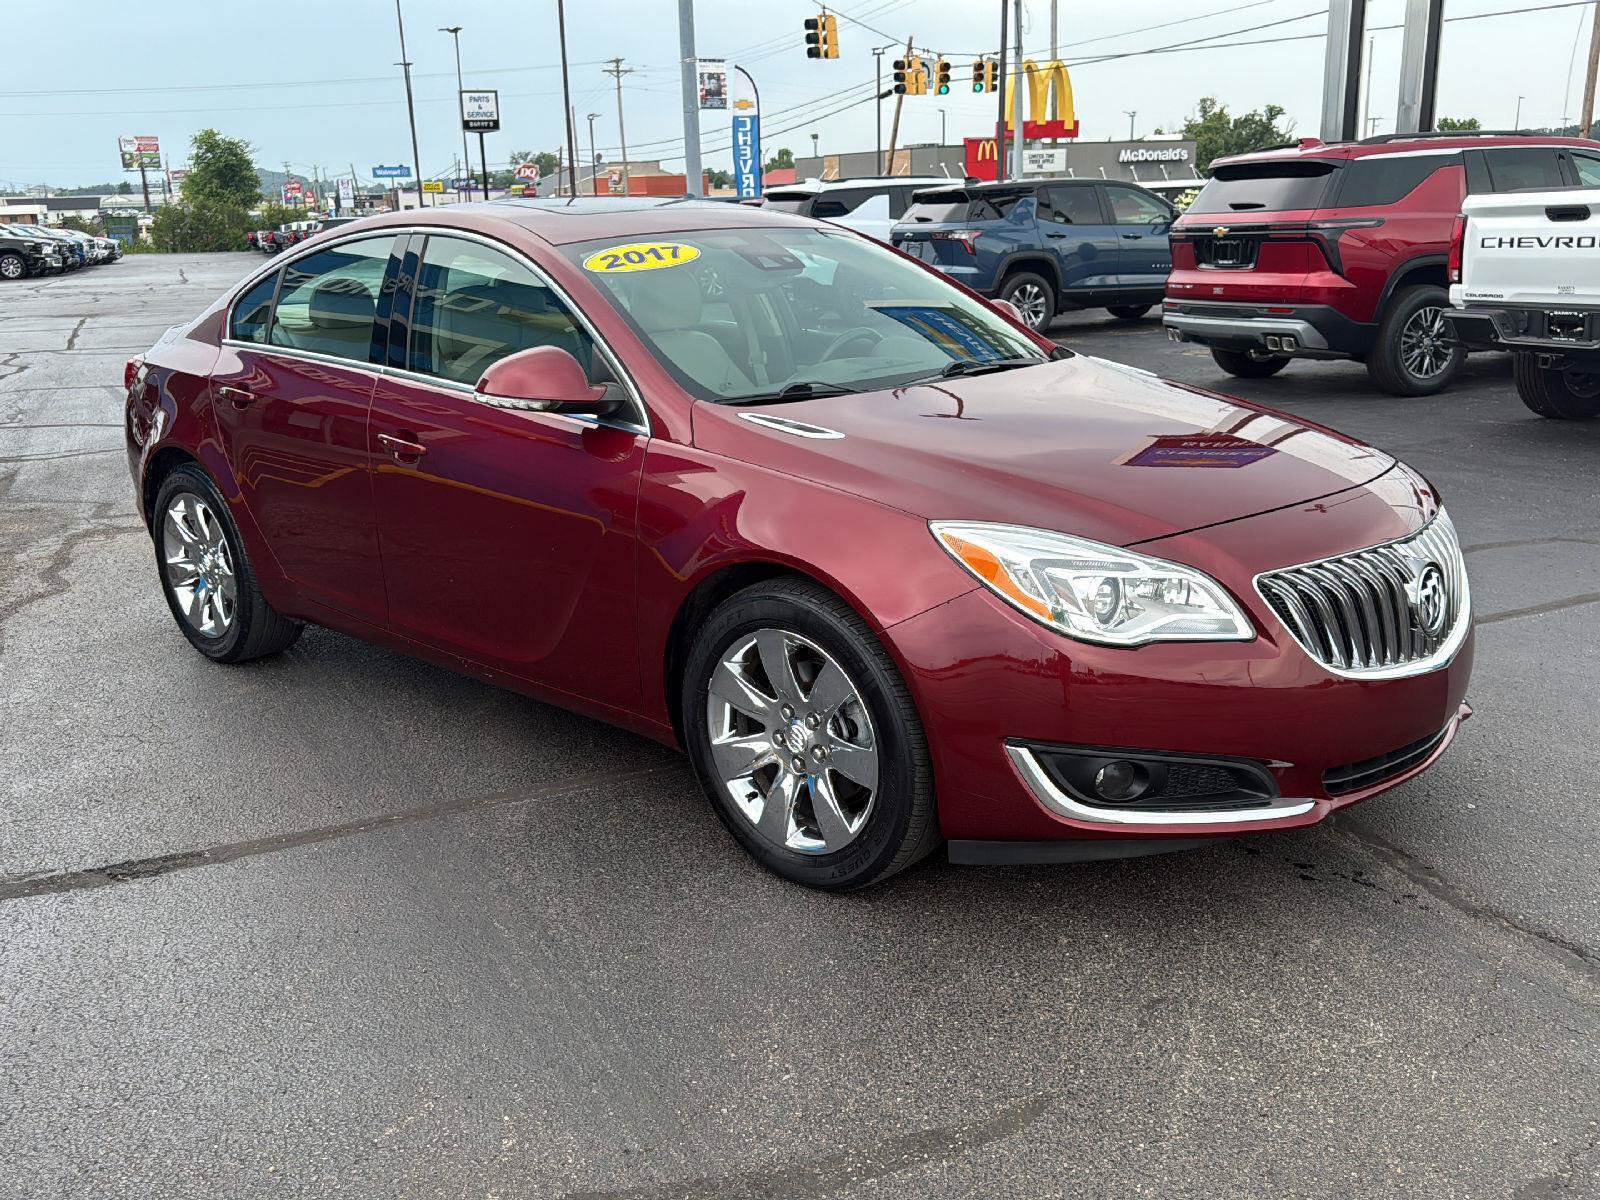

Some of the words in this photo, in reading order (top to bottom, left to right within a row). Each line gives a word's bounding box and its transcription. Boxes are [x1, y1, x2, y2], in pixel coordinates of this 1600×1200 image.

[469, 95, 490, 103] PARTS
[1119, 147, 1189, 163] McDonald's
[520, 167, 537, 177] DQ
[1480, 236, 1600, 248] CHEVRO
[600, 246, 681, 270] 2017
